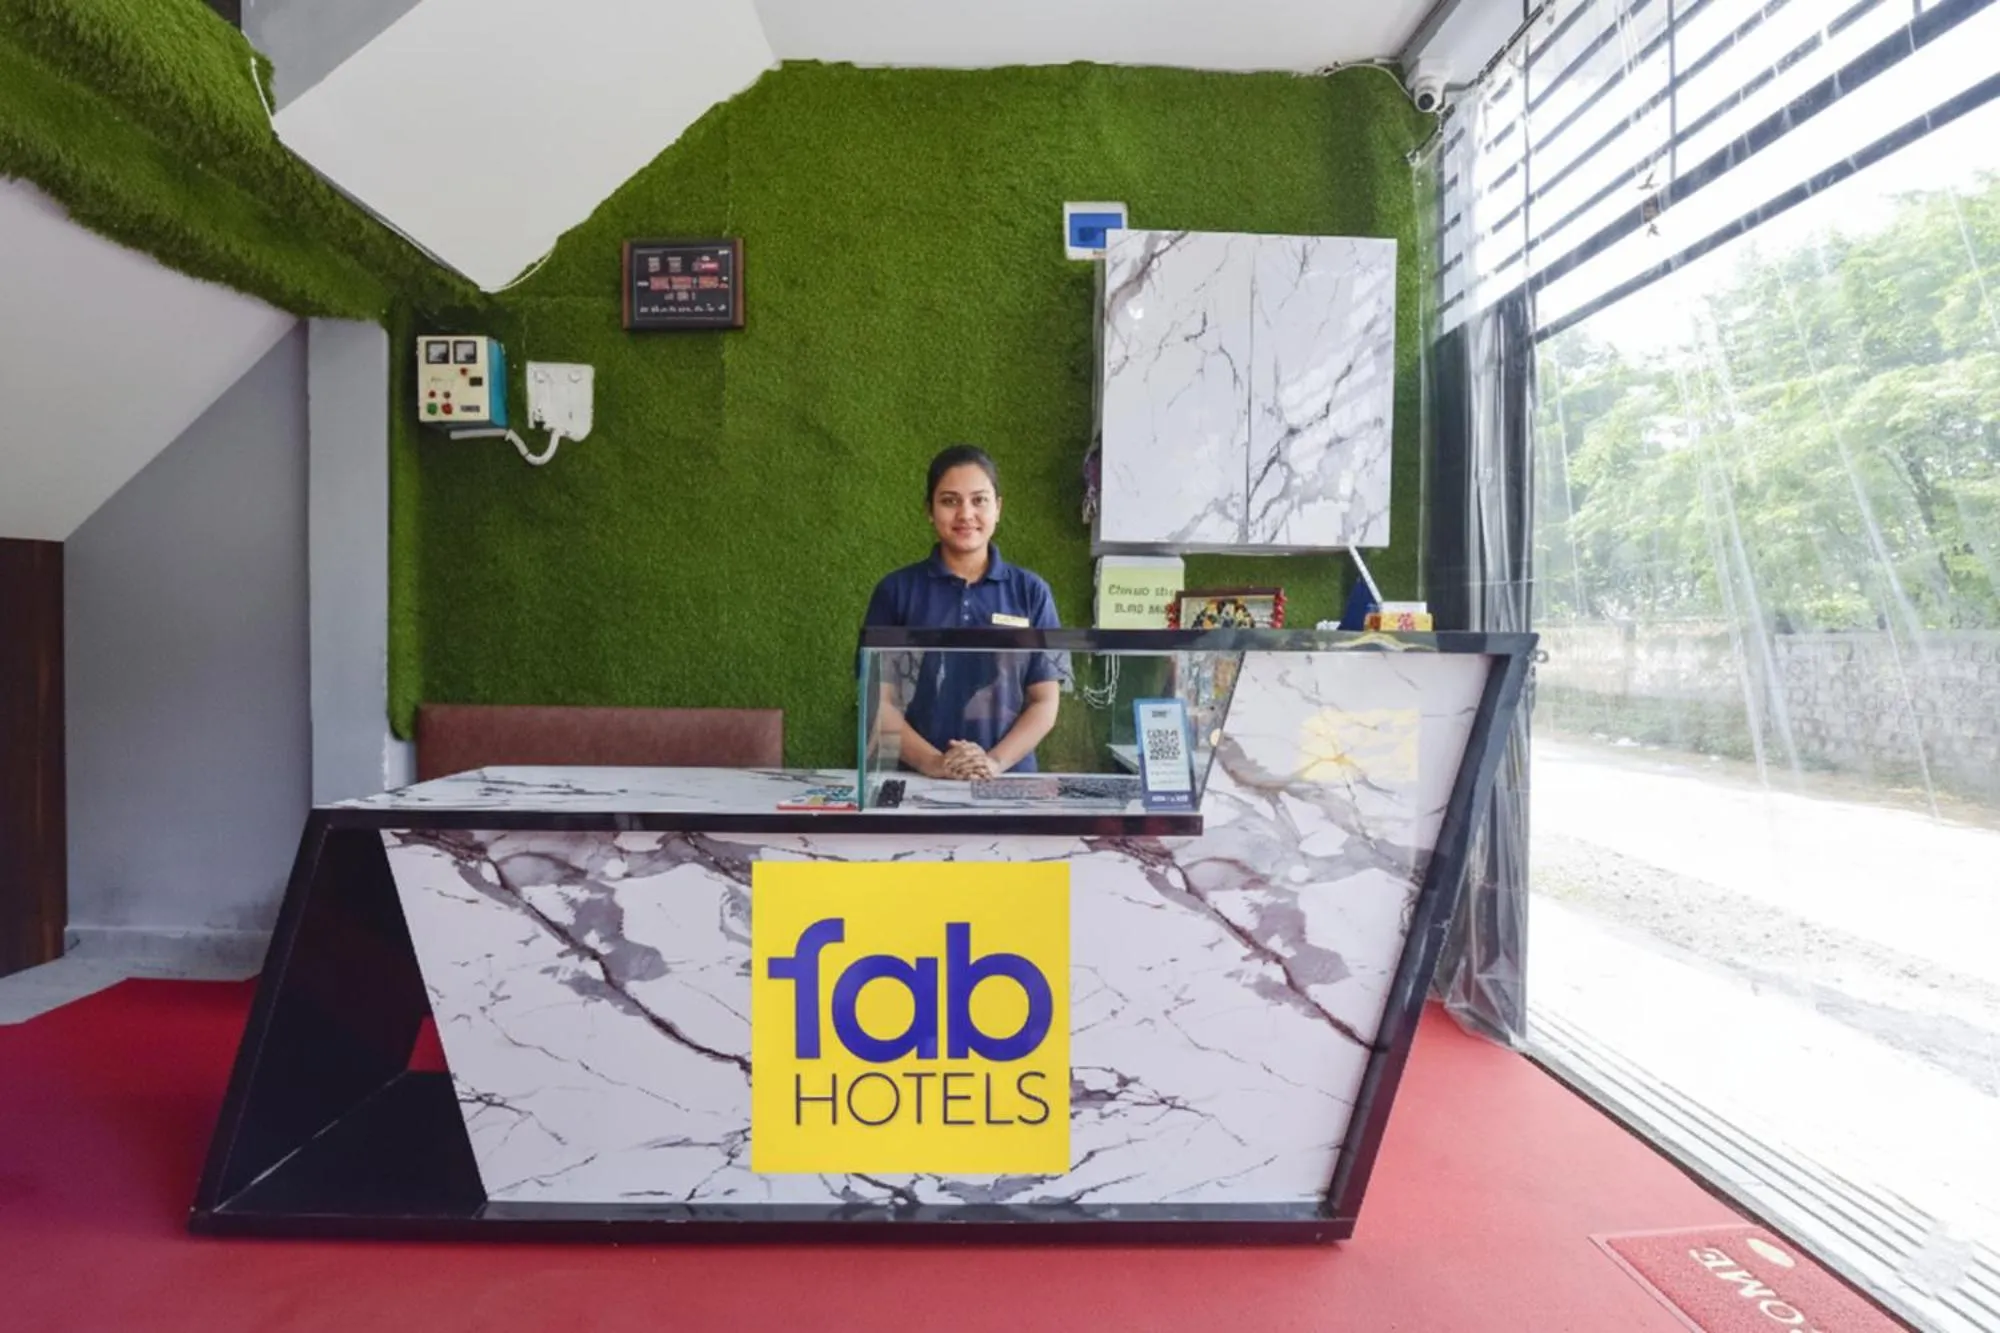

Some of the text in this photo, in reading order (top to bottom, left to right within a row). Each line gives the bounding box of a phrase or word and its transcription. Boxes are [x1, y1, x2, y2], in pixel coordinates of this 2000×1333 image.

[767, 917, 1053, 1063] fab
[795, 1071, 1050, 1126] HOTELS
[1688, 1247, 1824, 1333] OME
